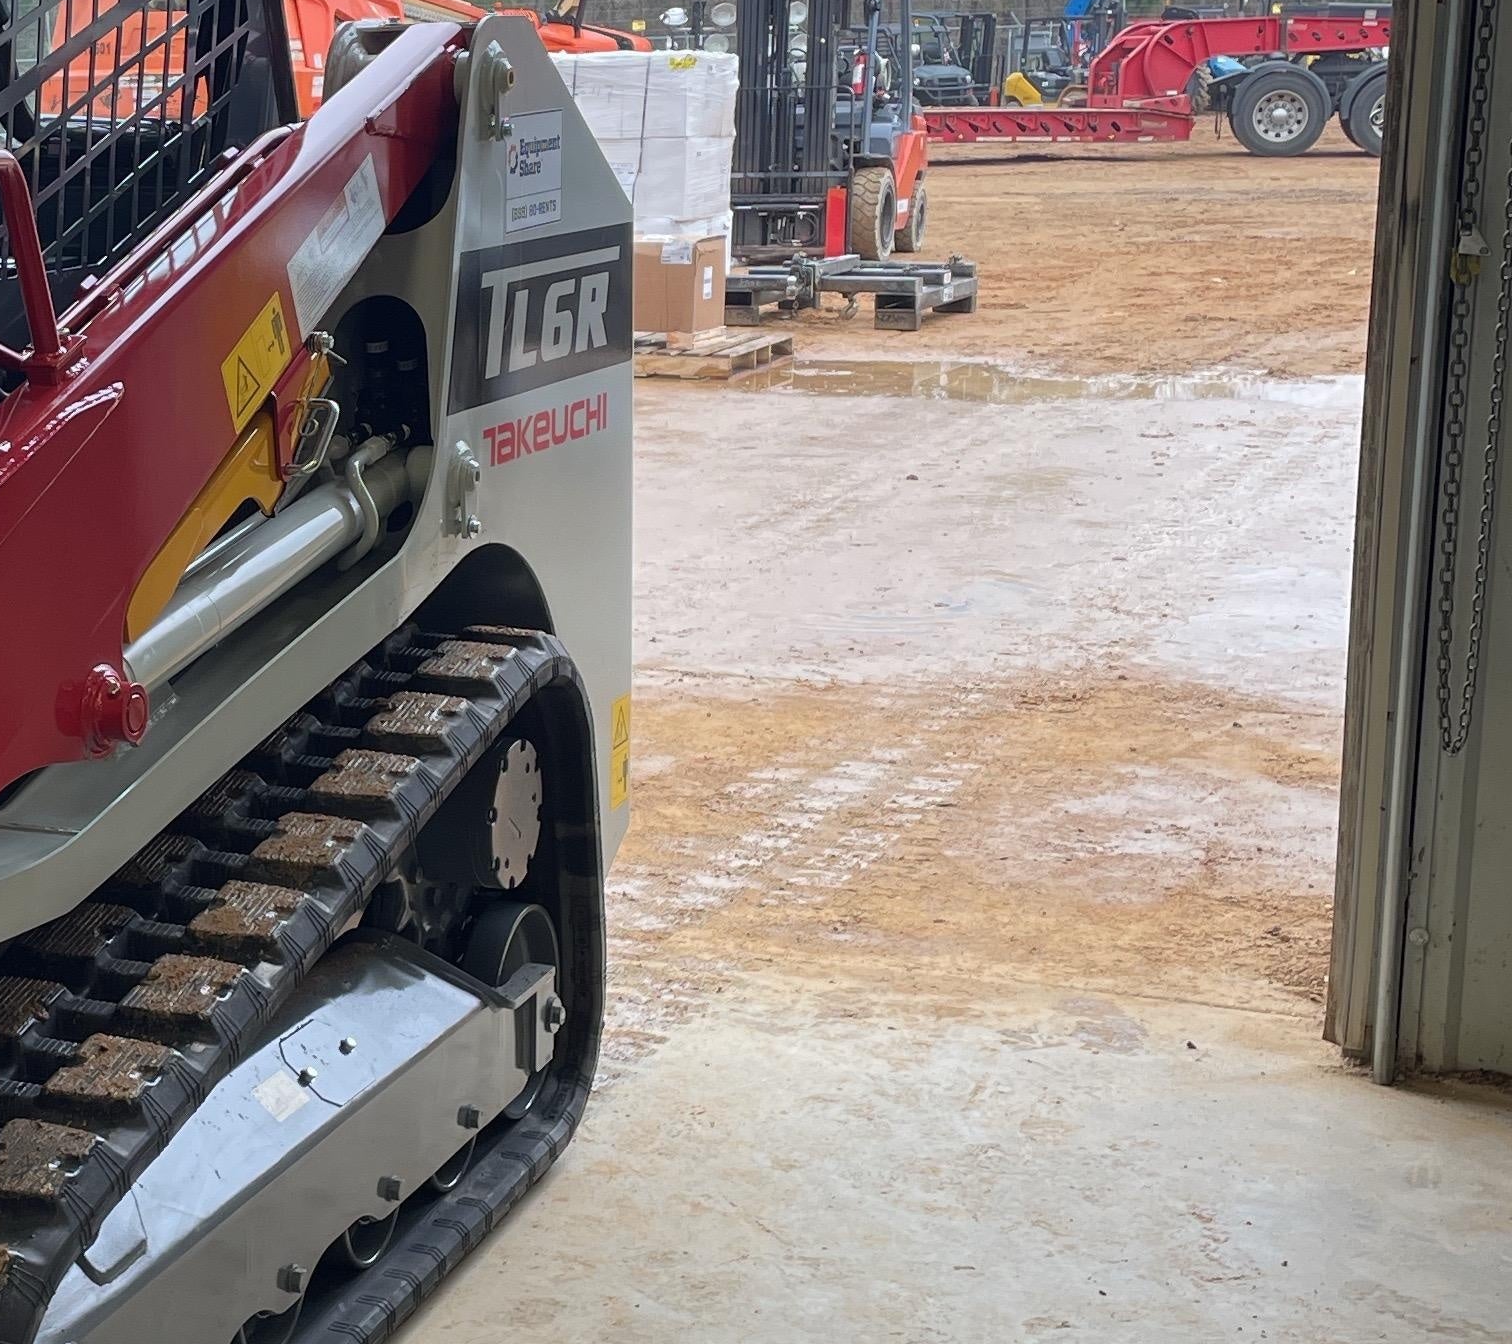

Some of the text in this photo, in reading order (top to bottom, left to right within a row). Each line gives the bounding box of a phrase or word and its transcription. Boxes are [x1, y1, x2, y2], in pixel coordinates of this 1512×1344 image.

[519, 135, 561, 158] Equipment
[519, 159, 542, 177] Share
[481, 246, 620, 380] TL6R
[482, 392, 607, 467] TAKEUCHI
